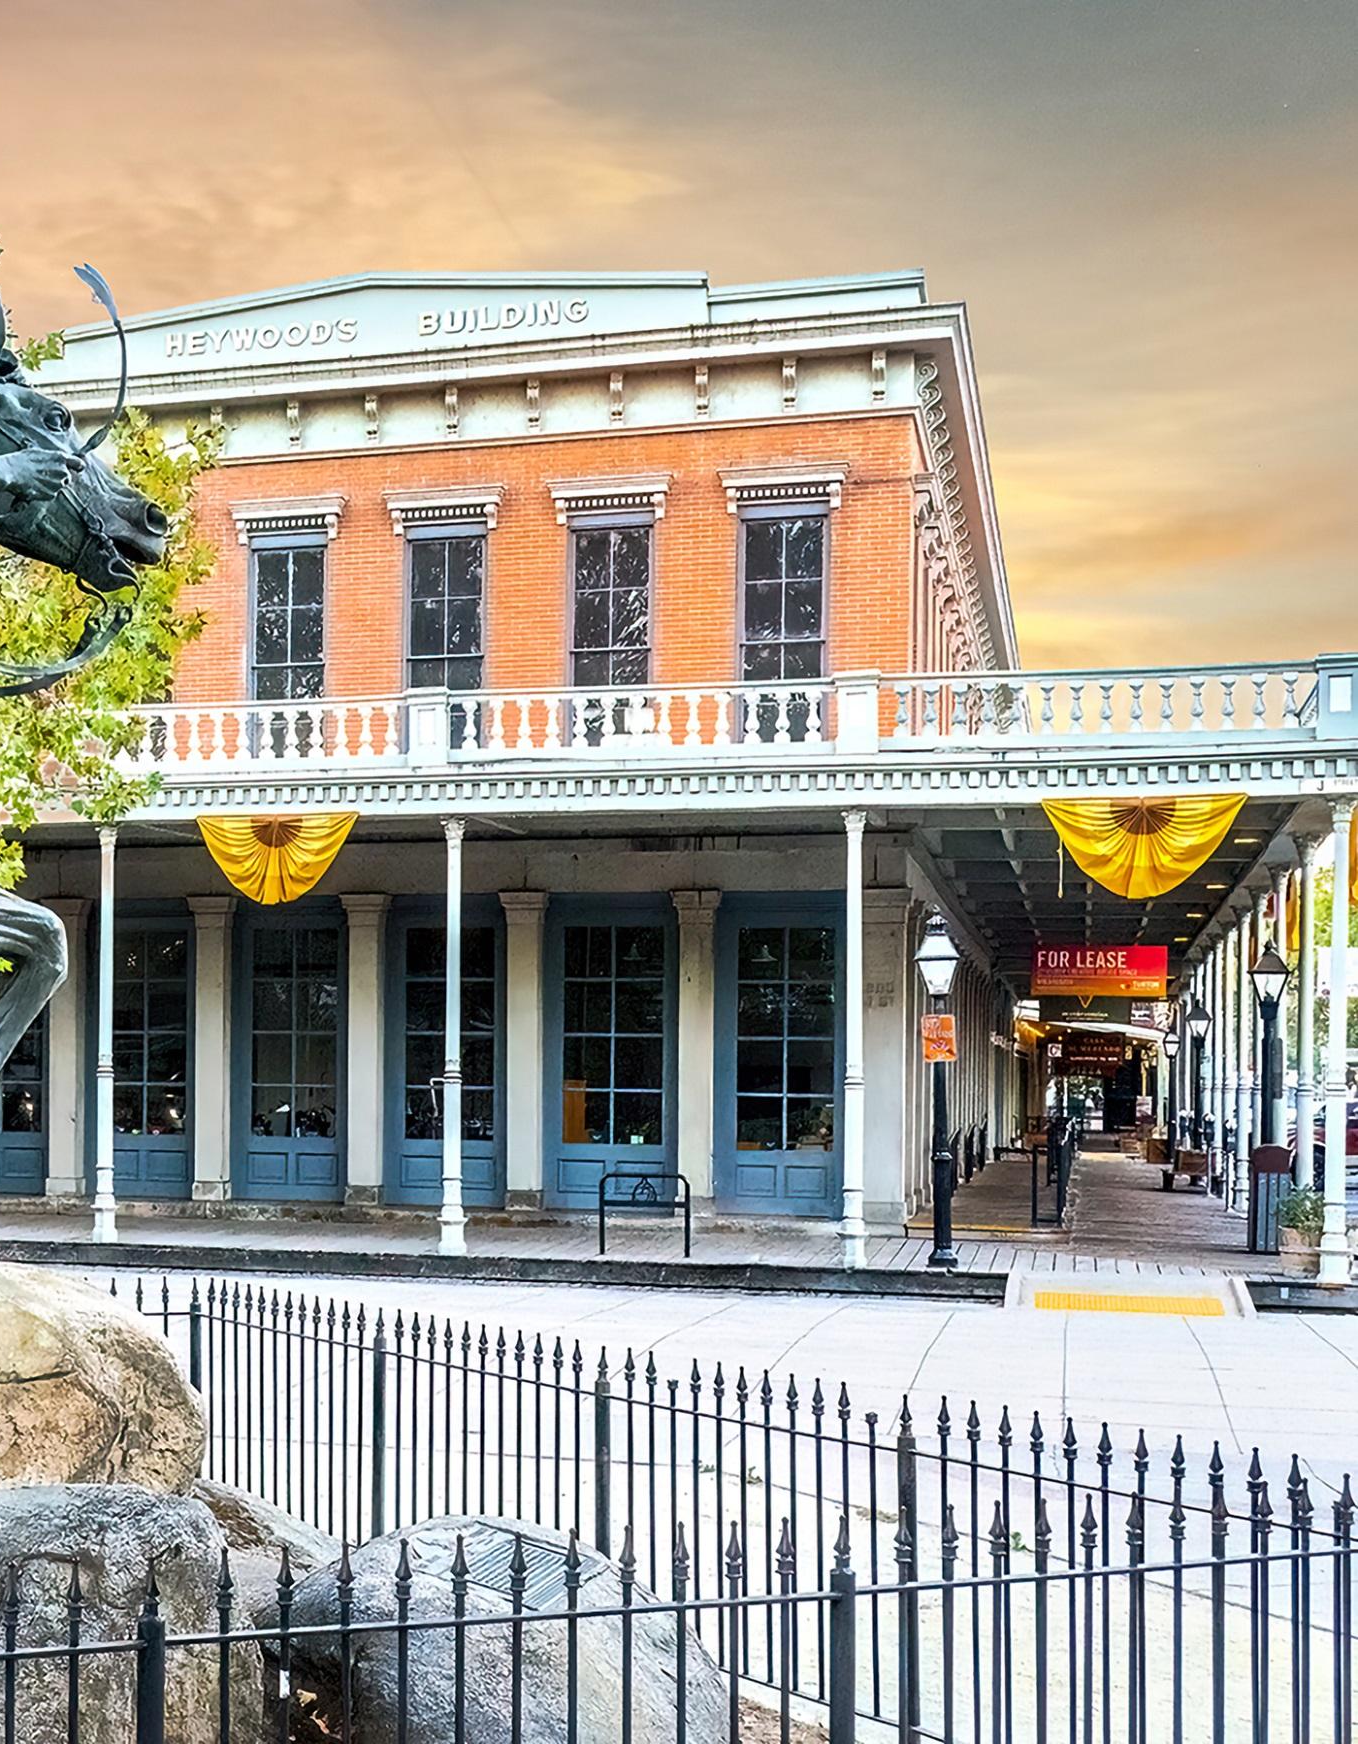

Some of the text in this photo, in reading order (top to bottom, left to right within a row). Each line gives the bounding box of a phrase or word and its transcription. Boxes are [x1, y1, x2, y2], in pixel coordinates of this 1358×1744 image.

[163, 298, 590, 358] HEYWOODS BUILDING
[1037, 950, 1128, 969] FOR LEASE
